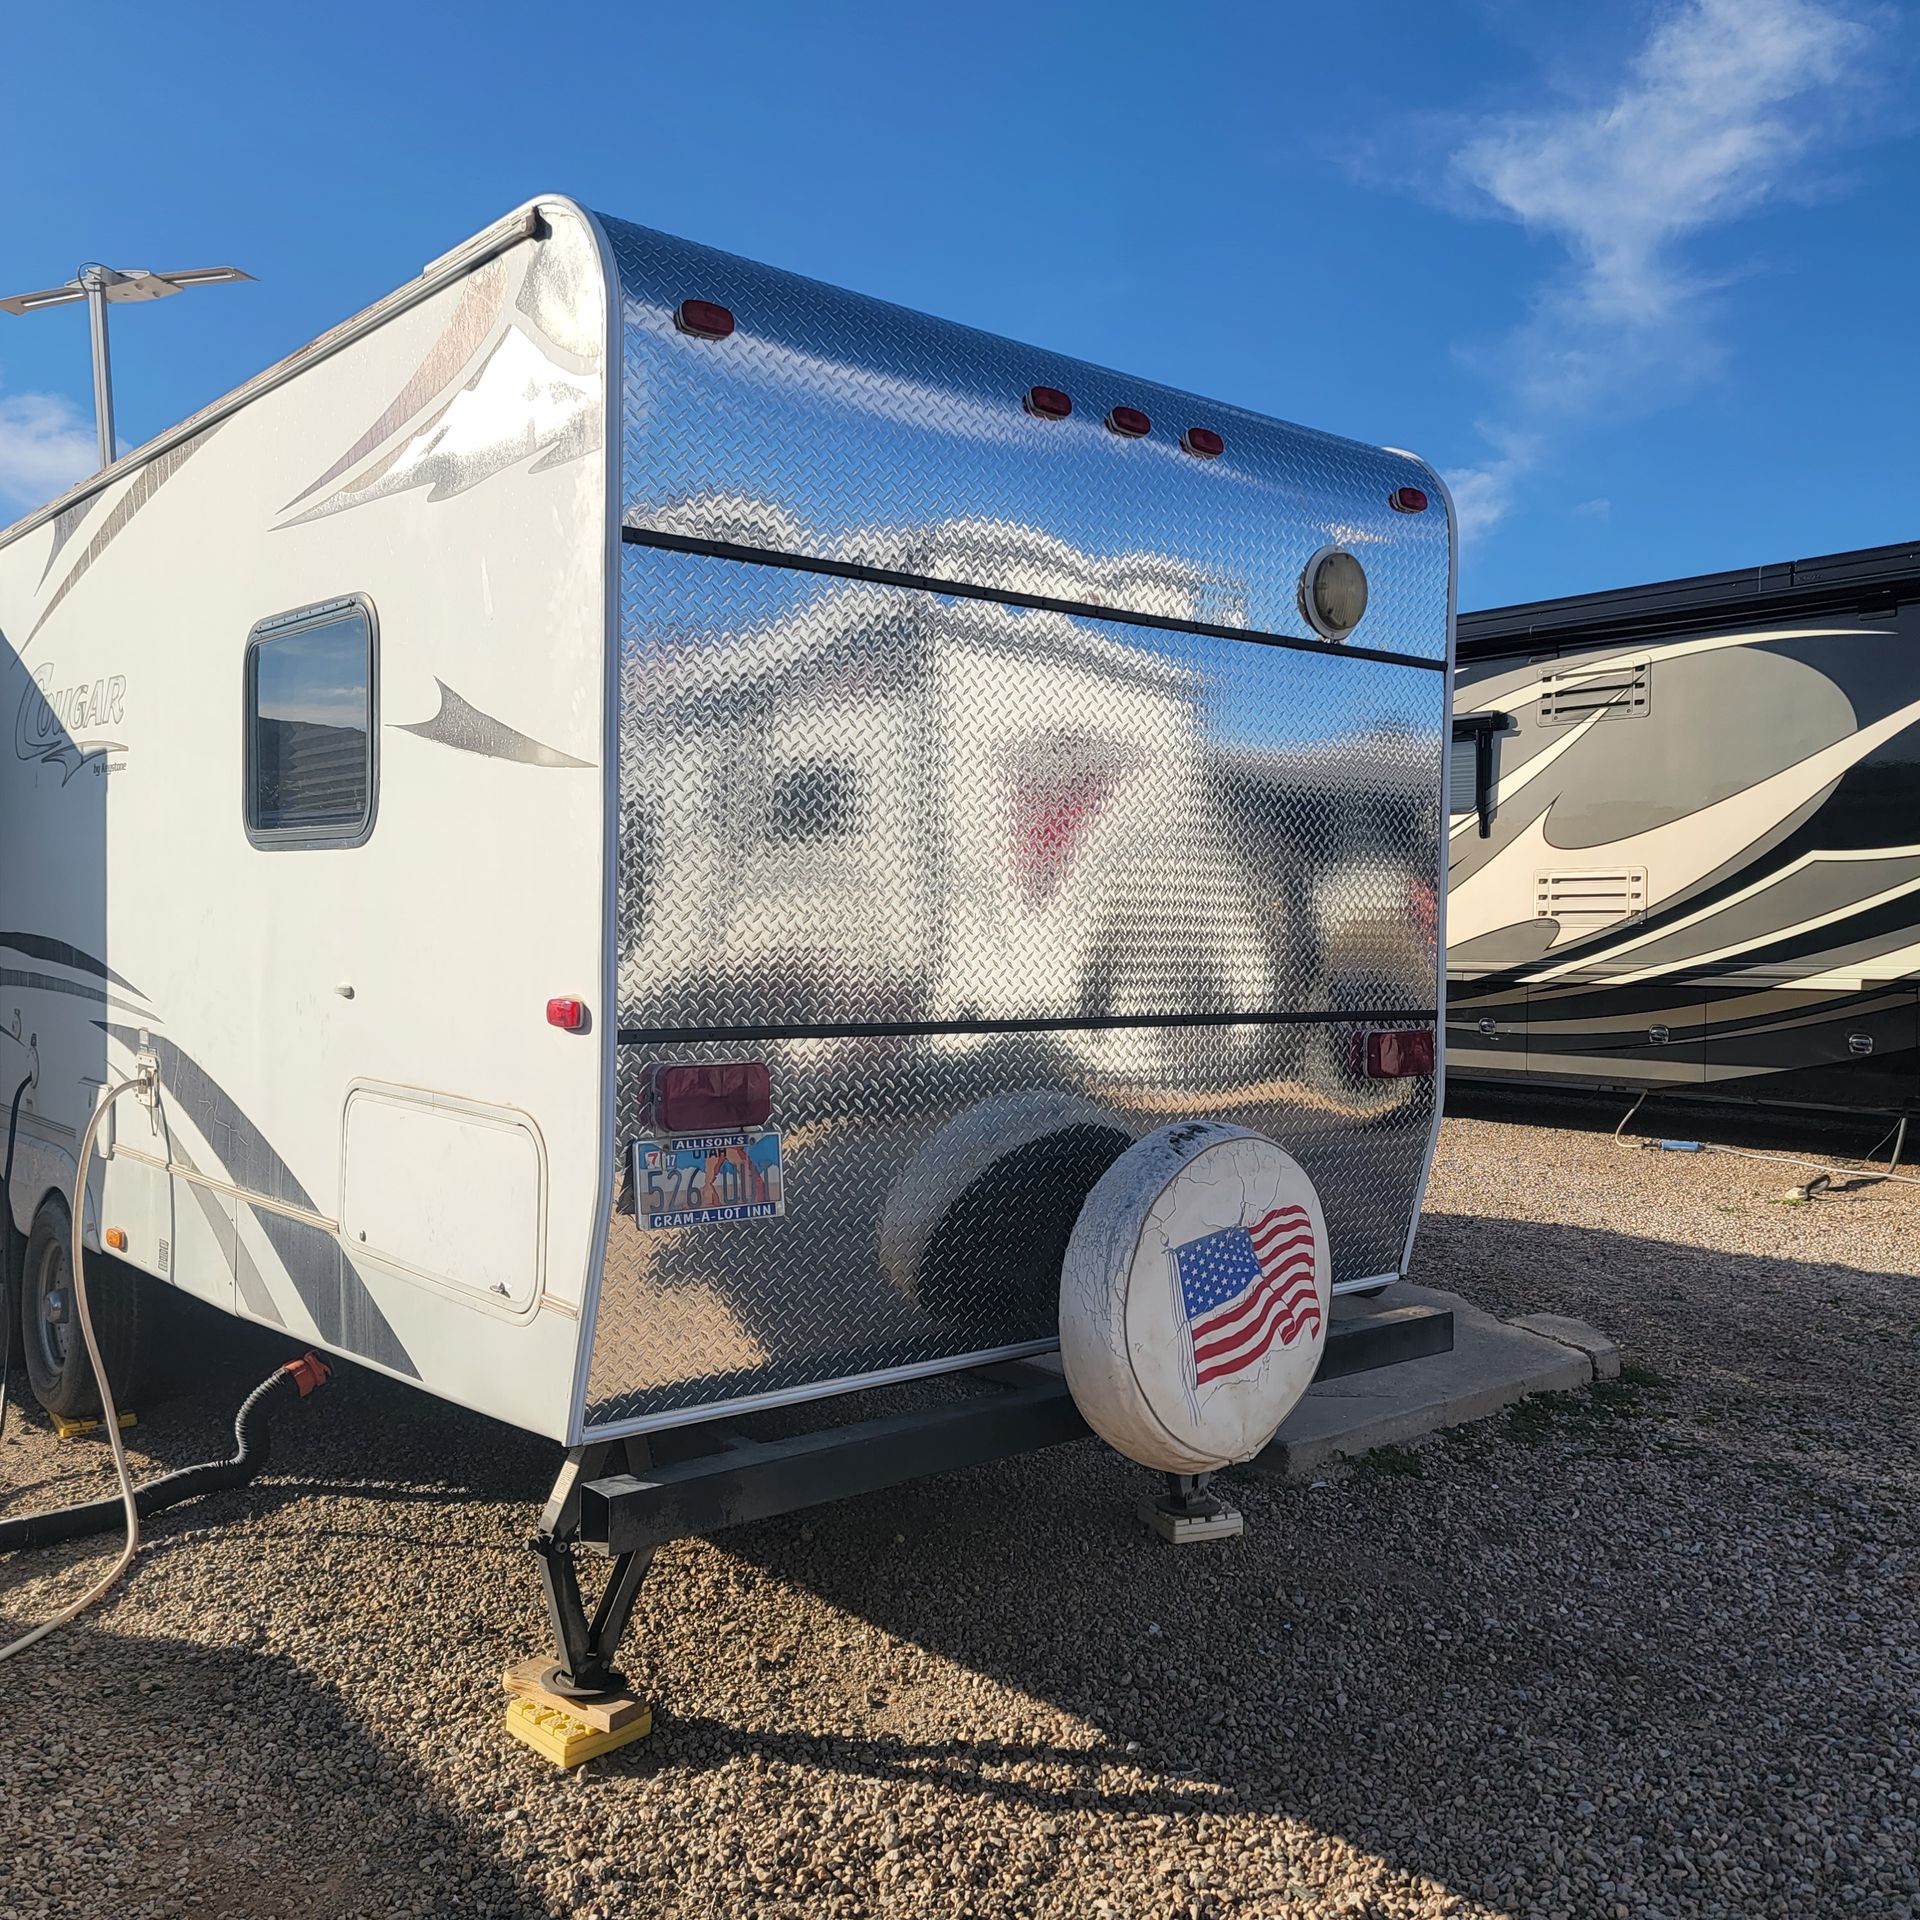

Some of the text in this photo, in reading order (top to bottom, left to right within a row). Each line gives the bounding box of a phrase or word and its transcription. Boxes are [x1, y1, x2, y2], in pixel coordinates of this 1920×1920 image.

[15, 662, 127, 761] COUGAR
[93, 763, 101, 776] by
[676, 1136, 745, 1149] ALLISON'S
[647, 1152, 659, 1165] 7
[692, 1147, 727, 1159] UTAH
[666, 1154, 676, 1166] 17
[648, 1168, 702, 1211] 526
[654, 1204, 772, 1228] CRAM-A-LOT INN
